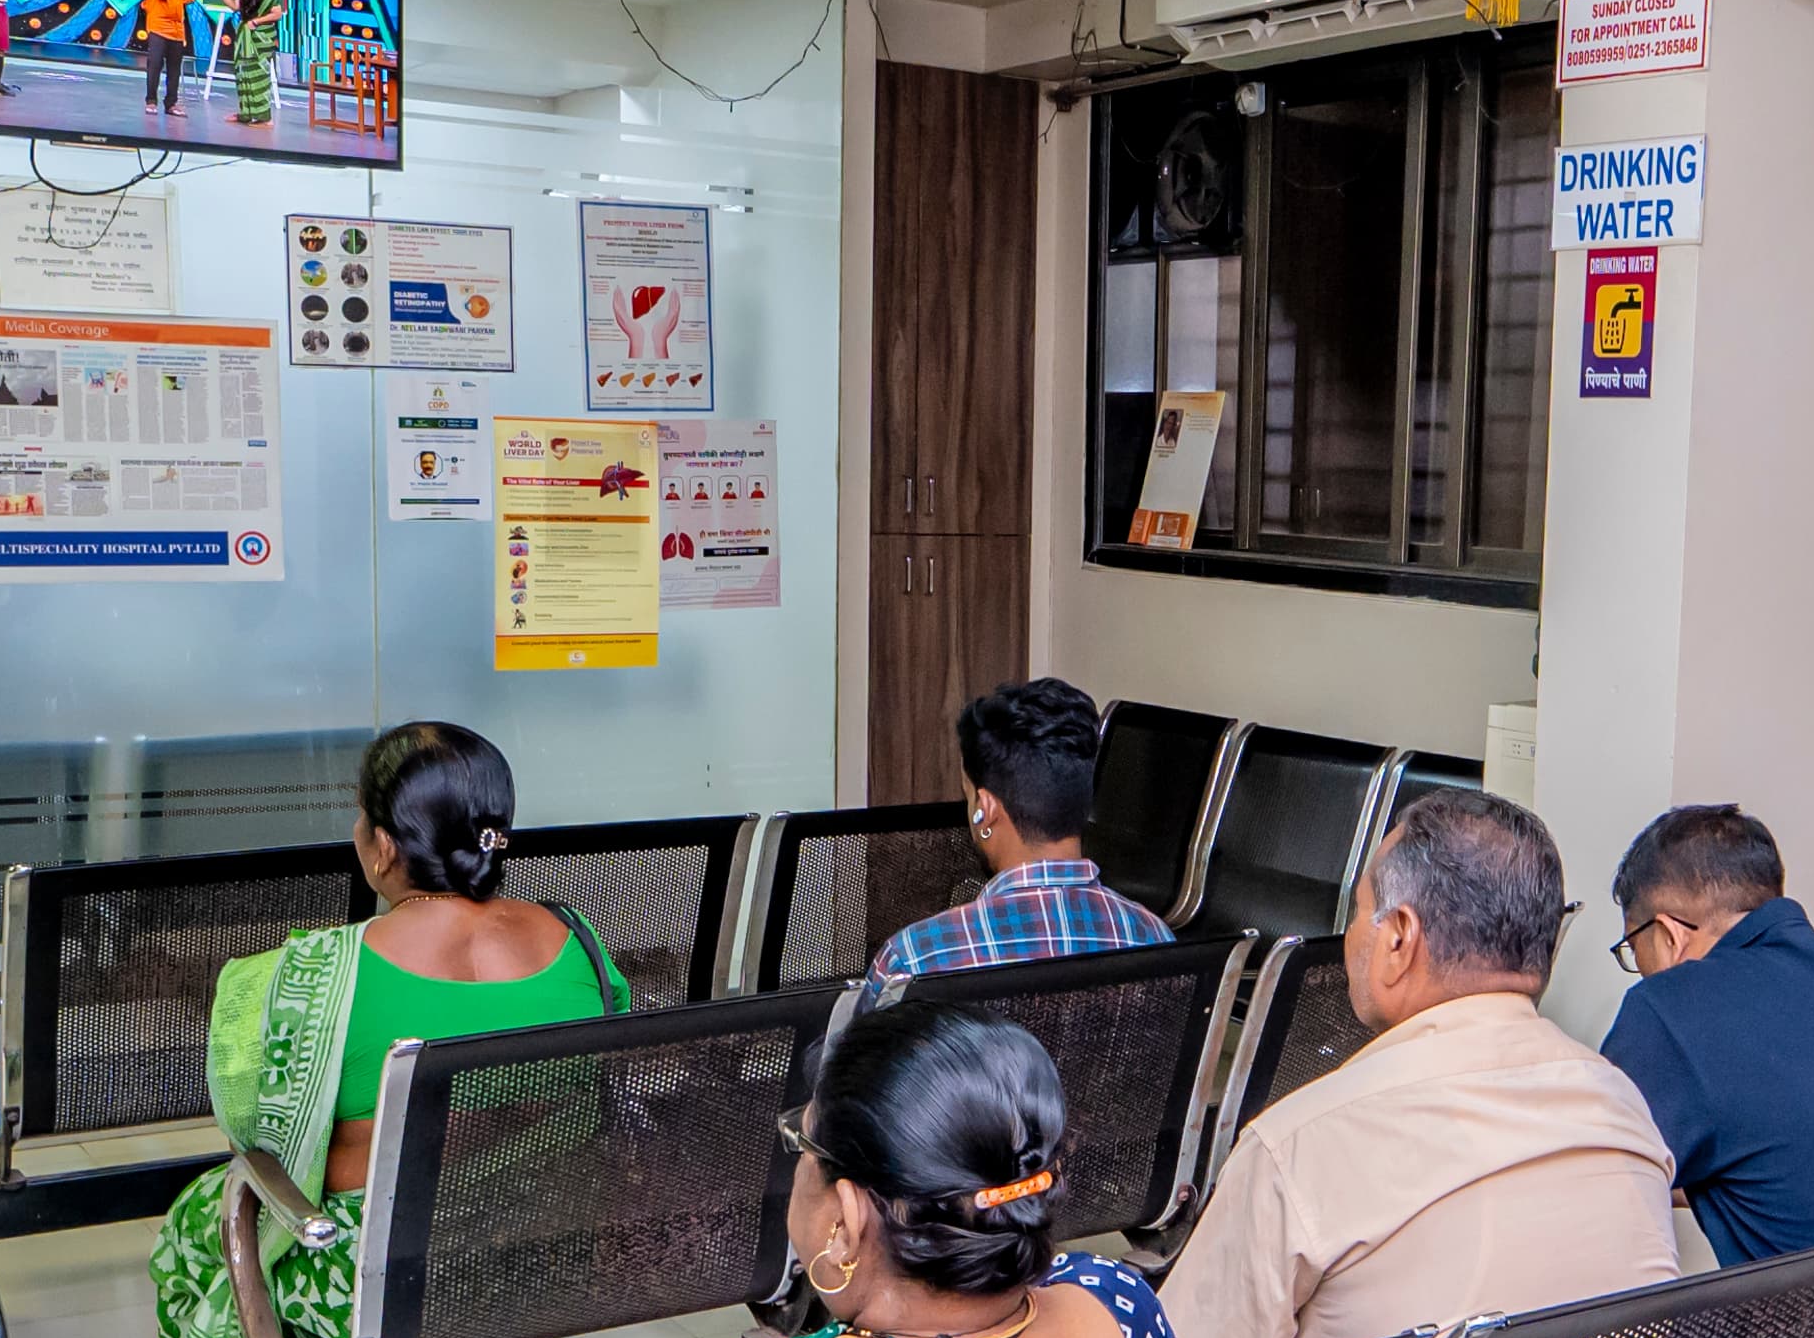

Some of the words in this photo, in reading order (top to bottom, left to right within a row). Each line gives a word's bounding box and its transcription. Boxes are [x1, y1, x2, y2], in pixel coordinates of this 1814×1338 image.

[1571, 27, 1590, 44] FOR
[1593, 17, 1667, 43] APPOINTMENT
[1669, 14, 1696, 32] CALL
[1560, 144, 1697, 192] DRINKING
[1576, 199, 1674, 241] WATER
[1589, 256, 1626, 275] DRINKING
[1628, 255, 1655, 273] WATER
[393, 291, 429, 300] DIABETIC
[394, 299, 446, 308] RETINOPATHY
[5, 320, 46, 334] Media
[48, 322, 110, 338] Coverage
[1585, 366, 1620, 389] पिण्याचे
[1623, 366, 1647, 389] पाणी
[428, 401, 450, 409] COPD
[508, 440, 542, 448] WORLD
[102, 544, 166, 554] HOSPITAL
[169, 544, 221, 555] PVT.LTD
